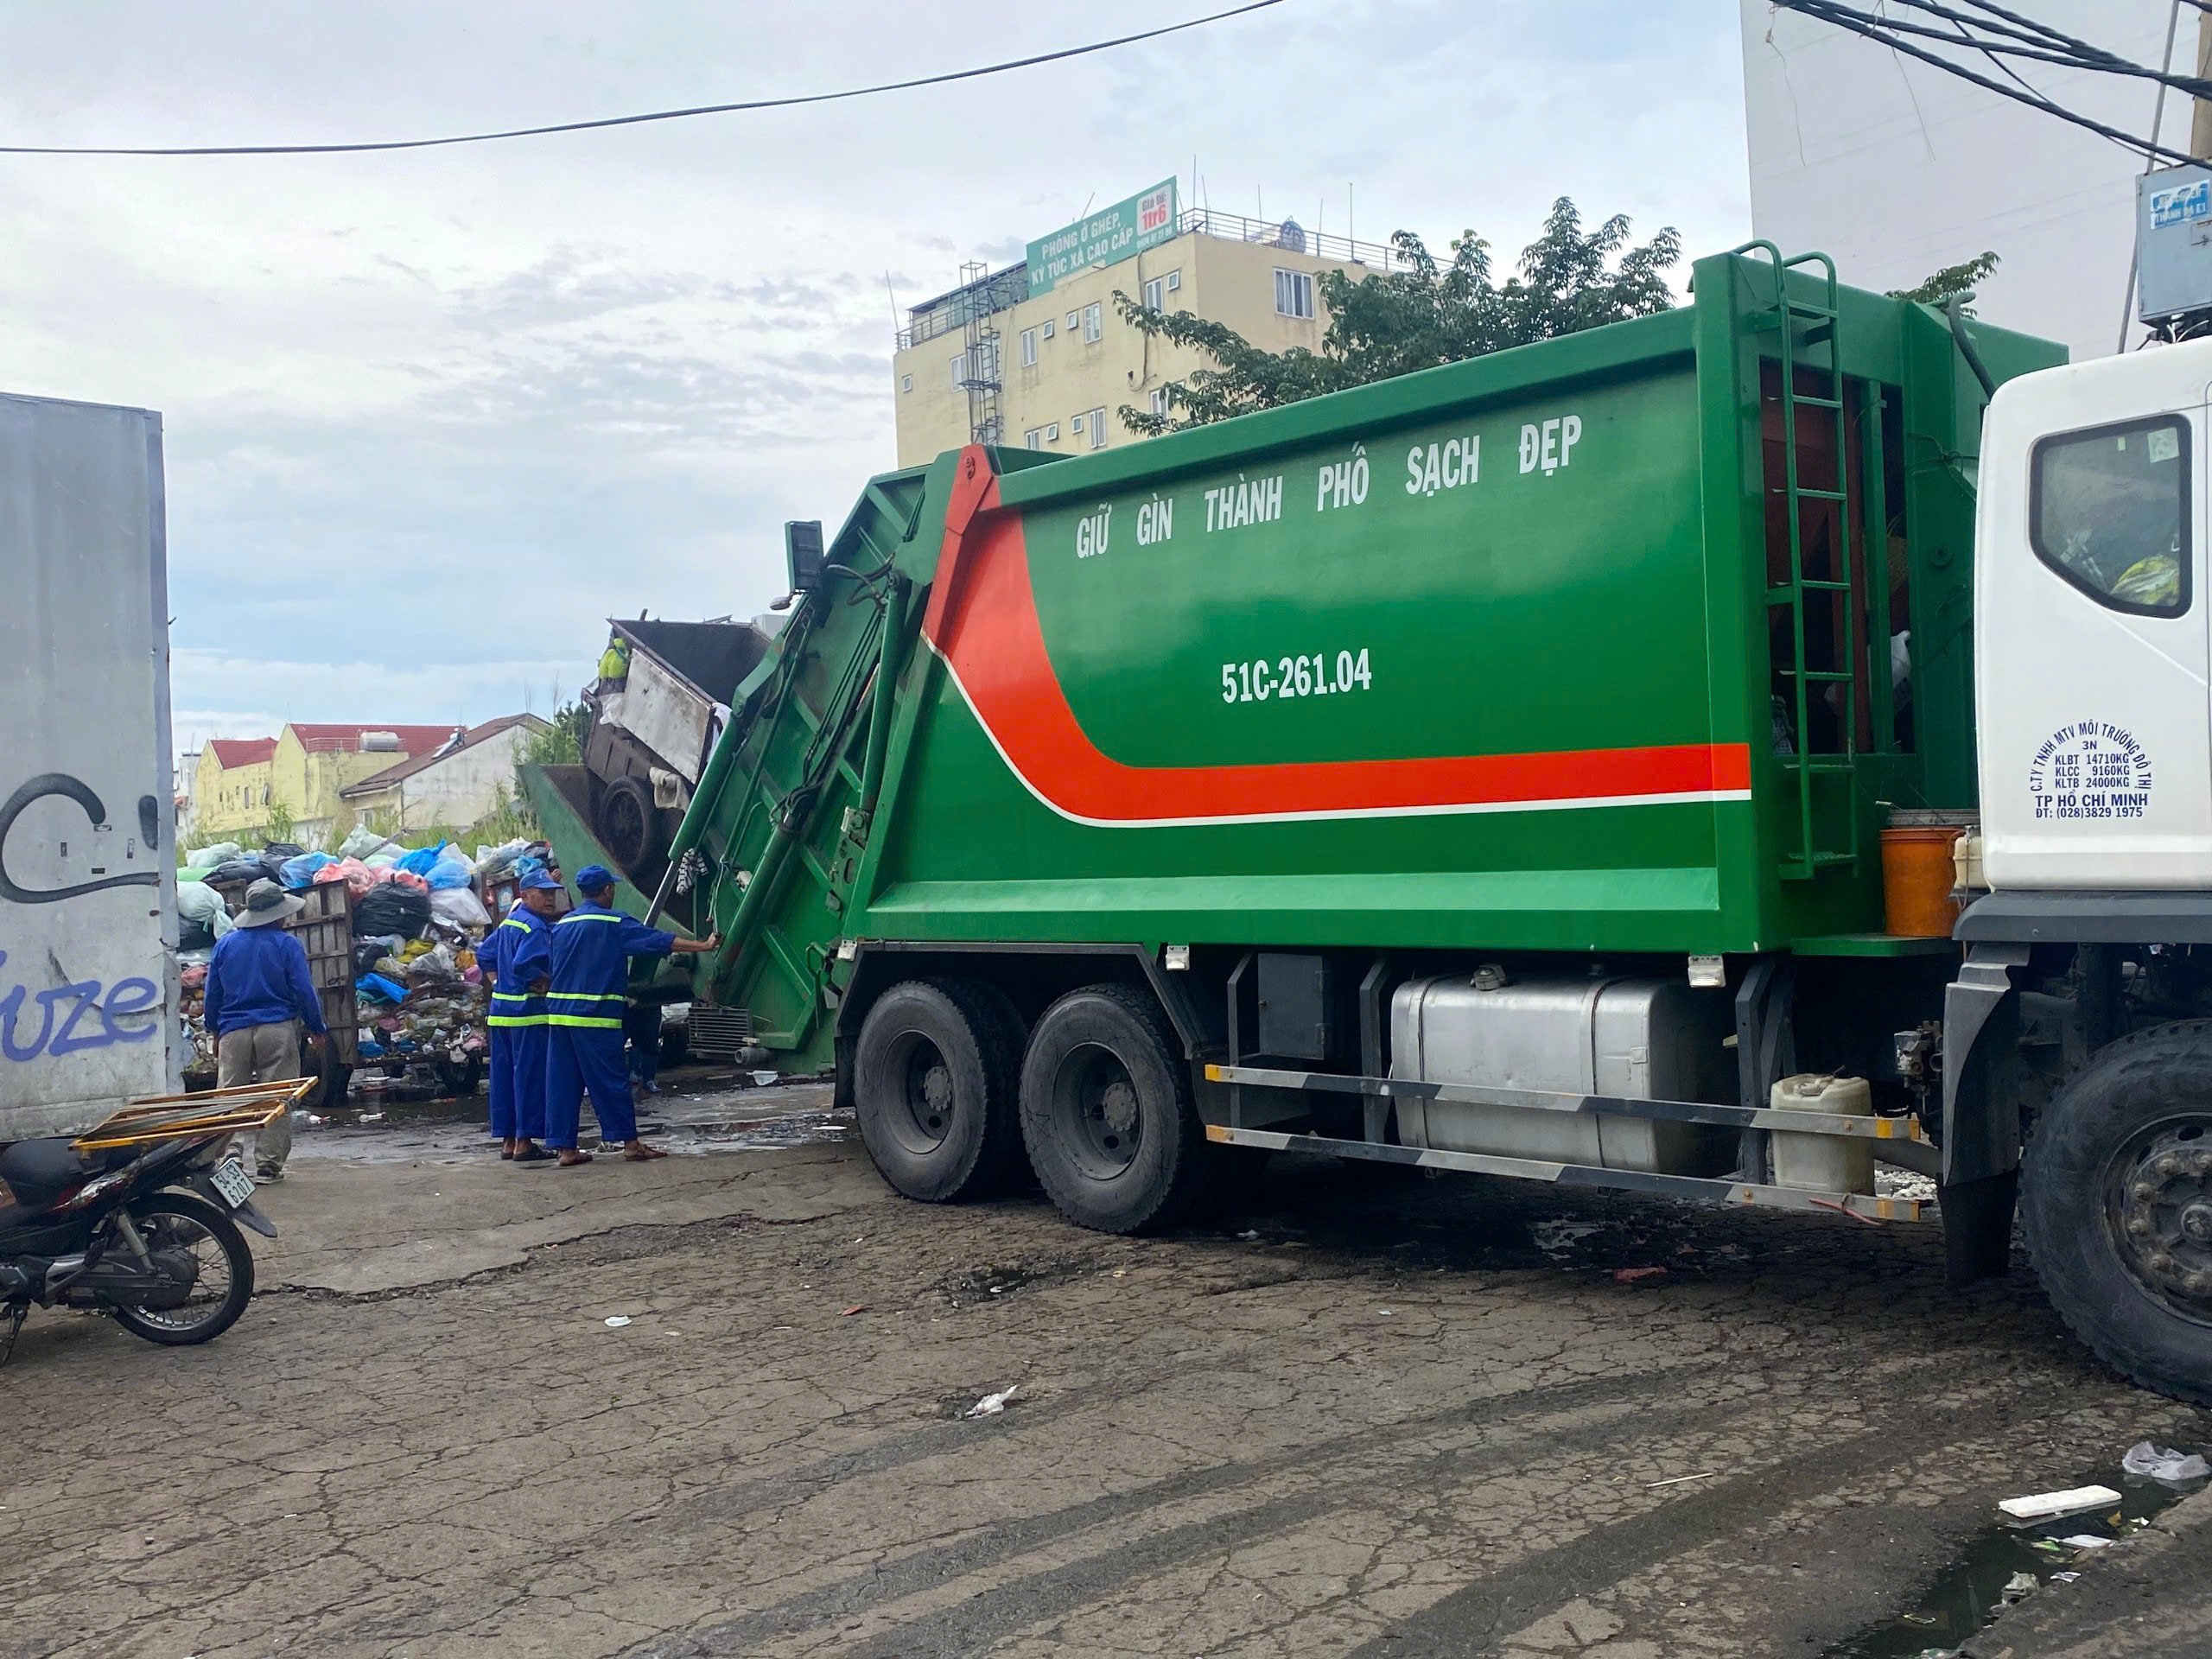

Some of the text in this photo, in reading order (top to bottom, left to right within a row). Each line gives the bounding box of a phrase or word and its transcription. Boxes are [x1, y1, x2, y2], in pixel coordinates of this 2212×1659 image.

[1041, 231, 1078, 260] PHÒNG
[1047, 257, 1068, 279] TÚC
[1086, 238, 1109, 262] CAO
[1076, 414, 1583, 559] GIỮ GÌN THÀNH PHỐ SẠCH ĐẸP
[1222, 647, 1373, 704] 51C-261.04
[2053, 725, 2075, 745] MTV
[2078, 719, 2099, 735] MÔI
[2033, 740, 2057, 766] TNHH
[2082, 741, 2098, 750] 3N
[2055, 753, 2130, 766] KLBT 14710KG
[2133, 753, 2152, 770] ĐÔ
[2030, 768, 2044, 792] C.TY
[2055, 765, 2130, 777] KLCC 9160KG
[2055, 777, 2130, 789] KLTB 24000KG
[2134, 772, 2152, 790] THỊ
[2035, 789, 2148, 807] TP HỒ CHÍ MINH
[2036, 806, 2143, 819] ĐT: (028)3829 1975
[215, 1163, 240, 1189] 54-S3
[227, 1177, 251, 1204] 6207
